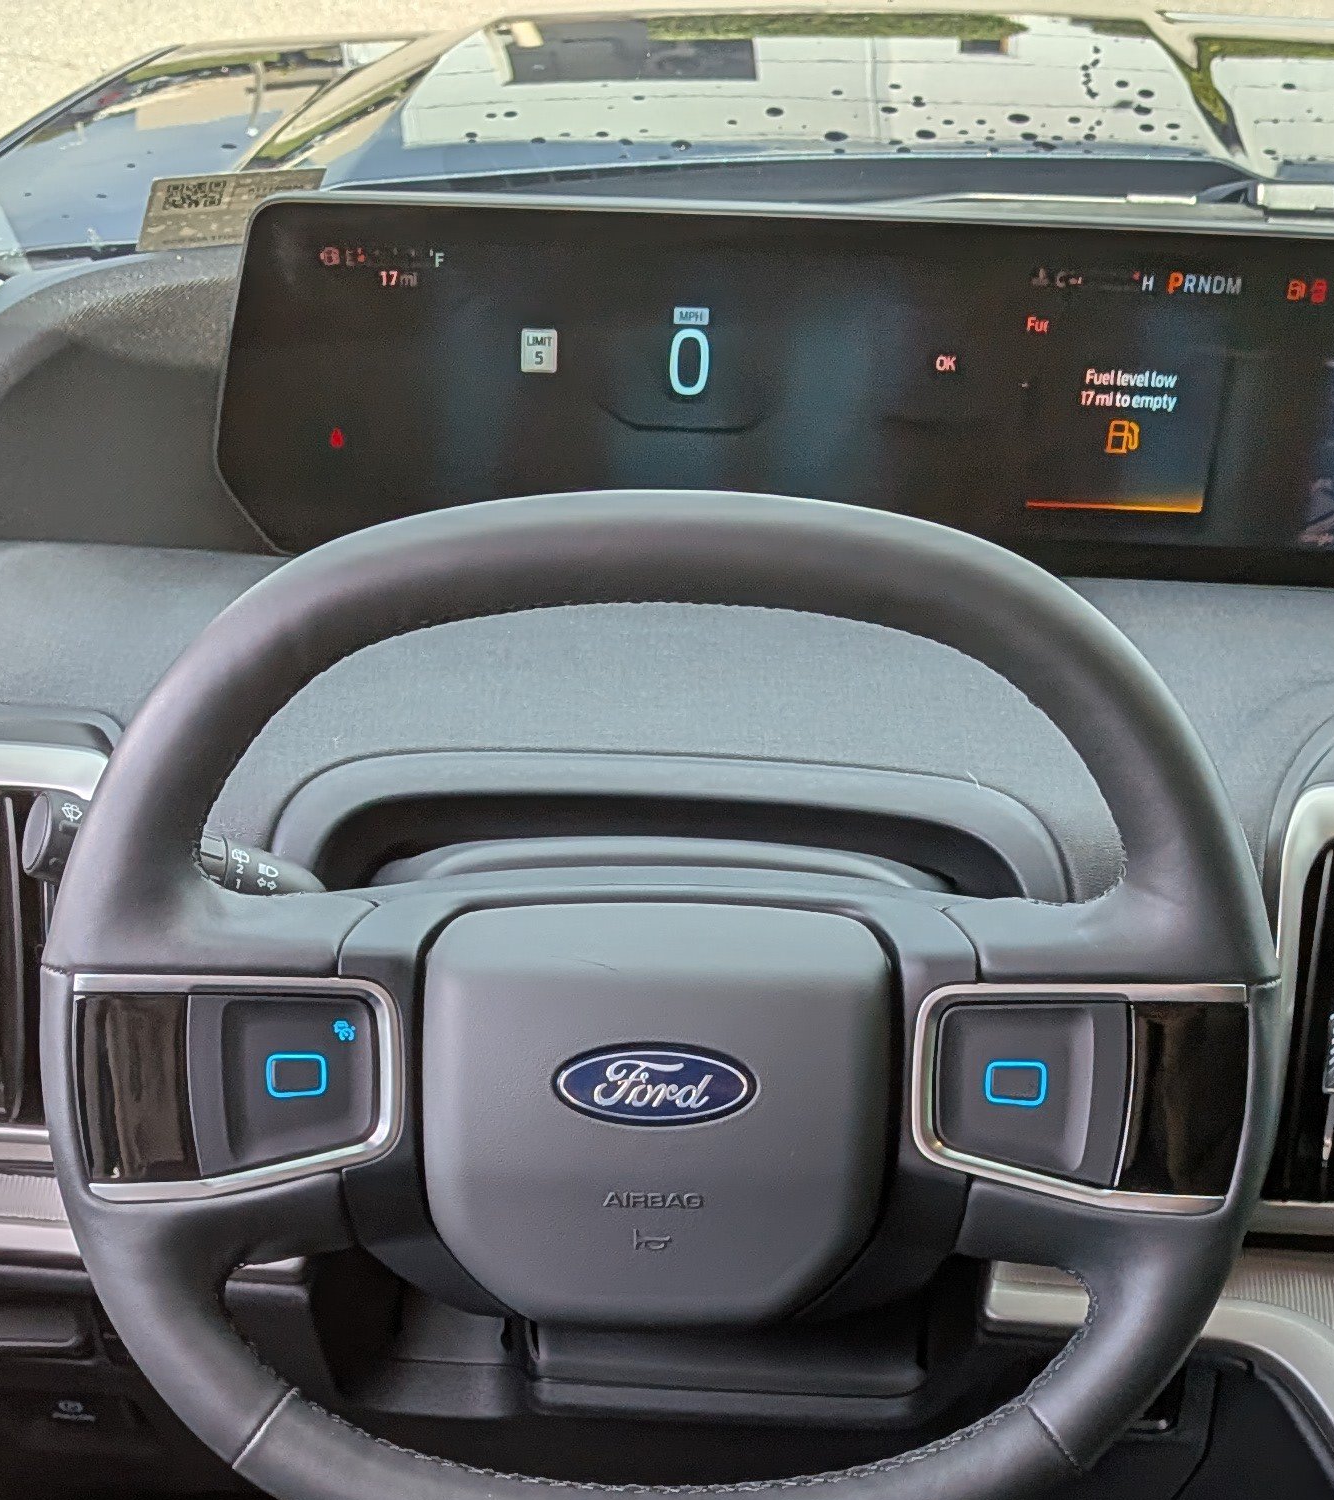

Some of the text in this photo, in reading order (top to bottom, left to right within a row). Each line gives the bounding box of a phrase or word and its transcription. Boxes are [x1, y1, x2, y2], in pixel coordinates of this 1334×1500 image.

[380, 271, 398, 286] 17
[1142, 275, 1154, 291] H
[678, 310, 704, 322] MPH
[526, 335, 553, 347] LIMIT
[534, 351, 543, 365] 5
[669, 328, 709, 396] 0
[935, 355, 957, 372] OK
[1085, 368, 1177, 388] Fuel level low
[1081, 391, 1177, 412] 17 mi to empty
[235, 863, 244, 875] 2
[235, 878, 242, 889] 1
[592, 1057, 717, 1111] Ford
[602, 1189, 704, 1210] AIRBAG
